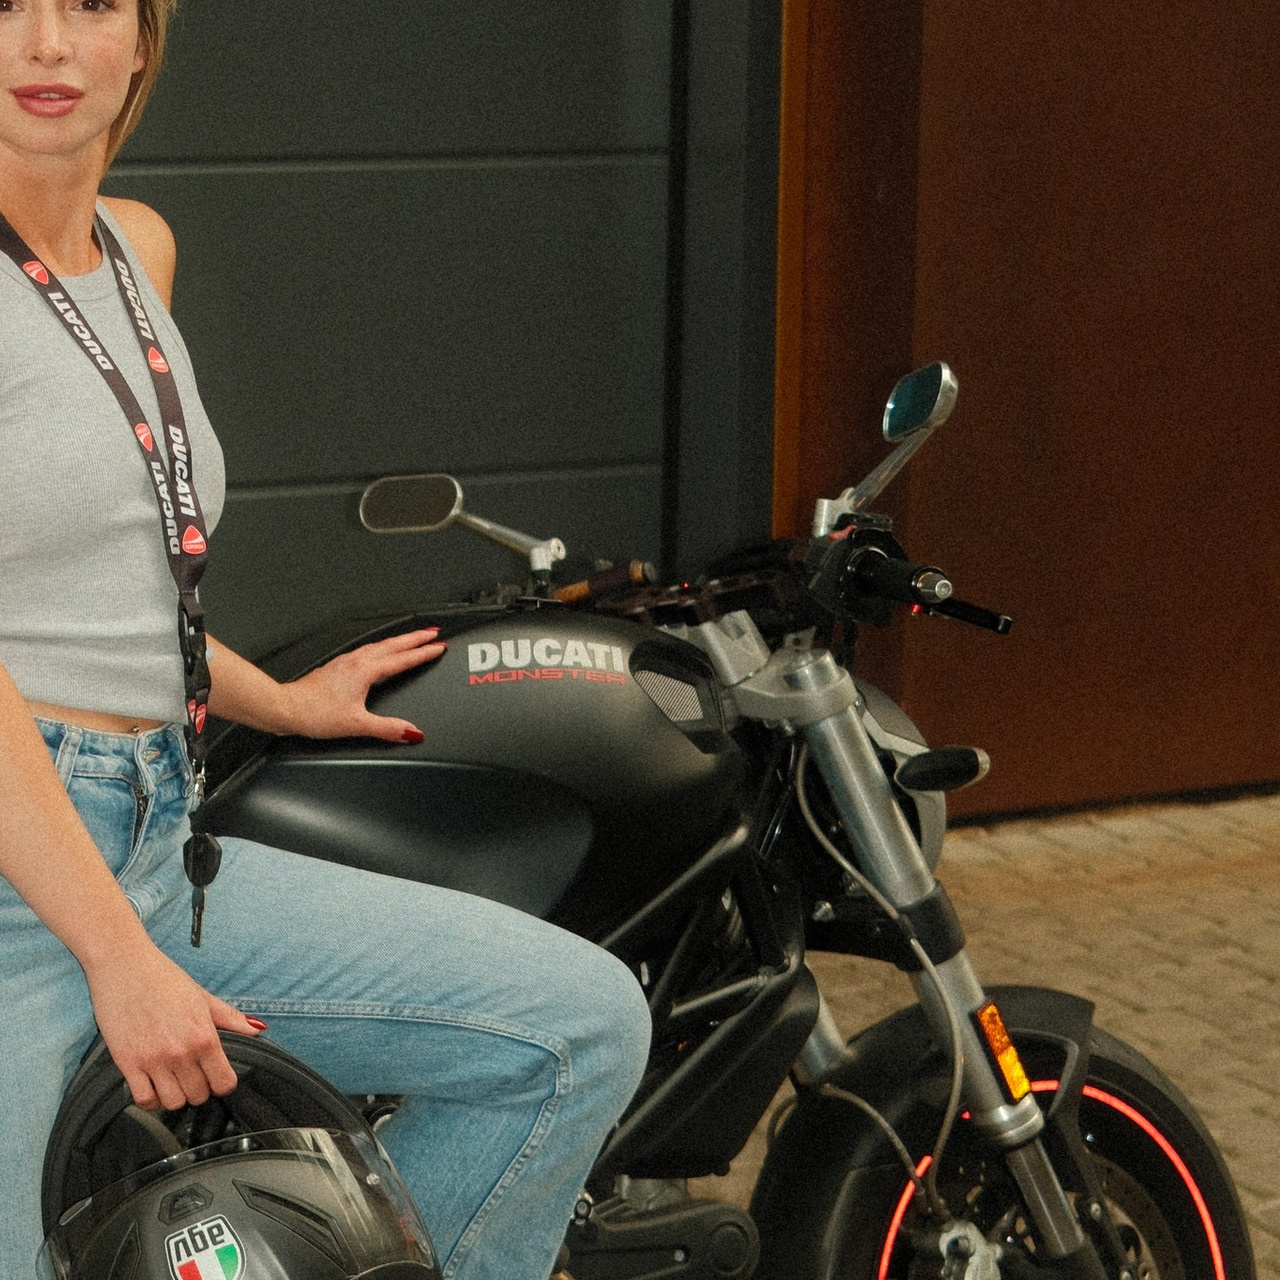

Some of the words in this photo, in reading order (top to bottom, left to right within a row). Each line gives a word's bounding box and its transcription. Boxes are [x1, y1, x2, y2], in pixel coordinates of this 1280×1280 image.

[48, 292, 114, 370] DUCATI
[114, 258, 154, 340] DUCATI
[150, 462, 180, 554] DUCATI
[168, 424, 196, 517] DUCATI
[467, 638, 624, 672] DUCATI
[469, 668, 625, 685] MONSTER
[174, 1223, 225, 1262] agv
